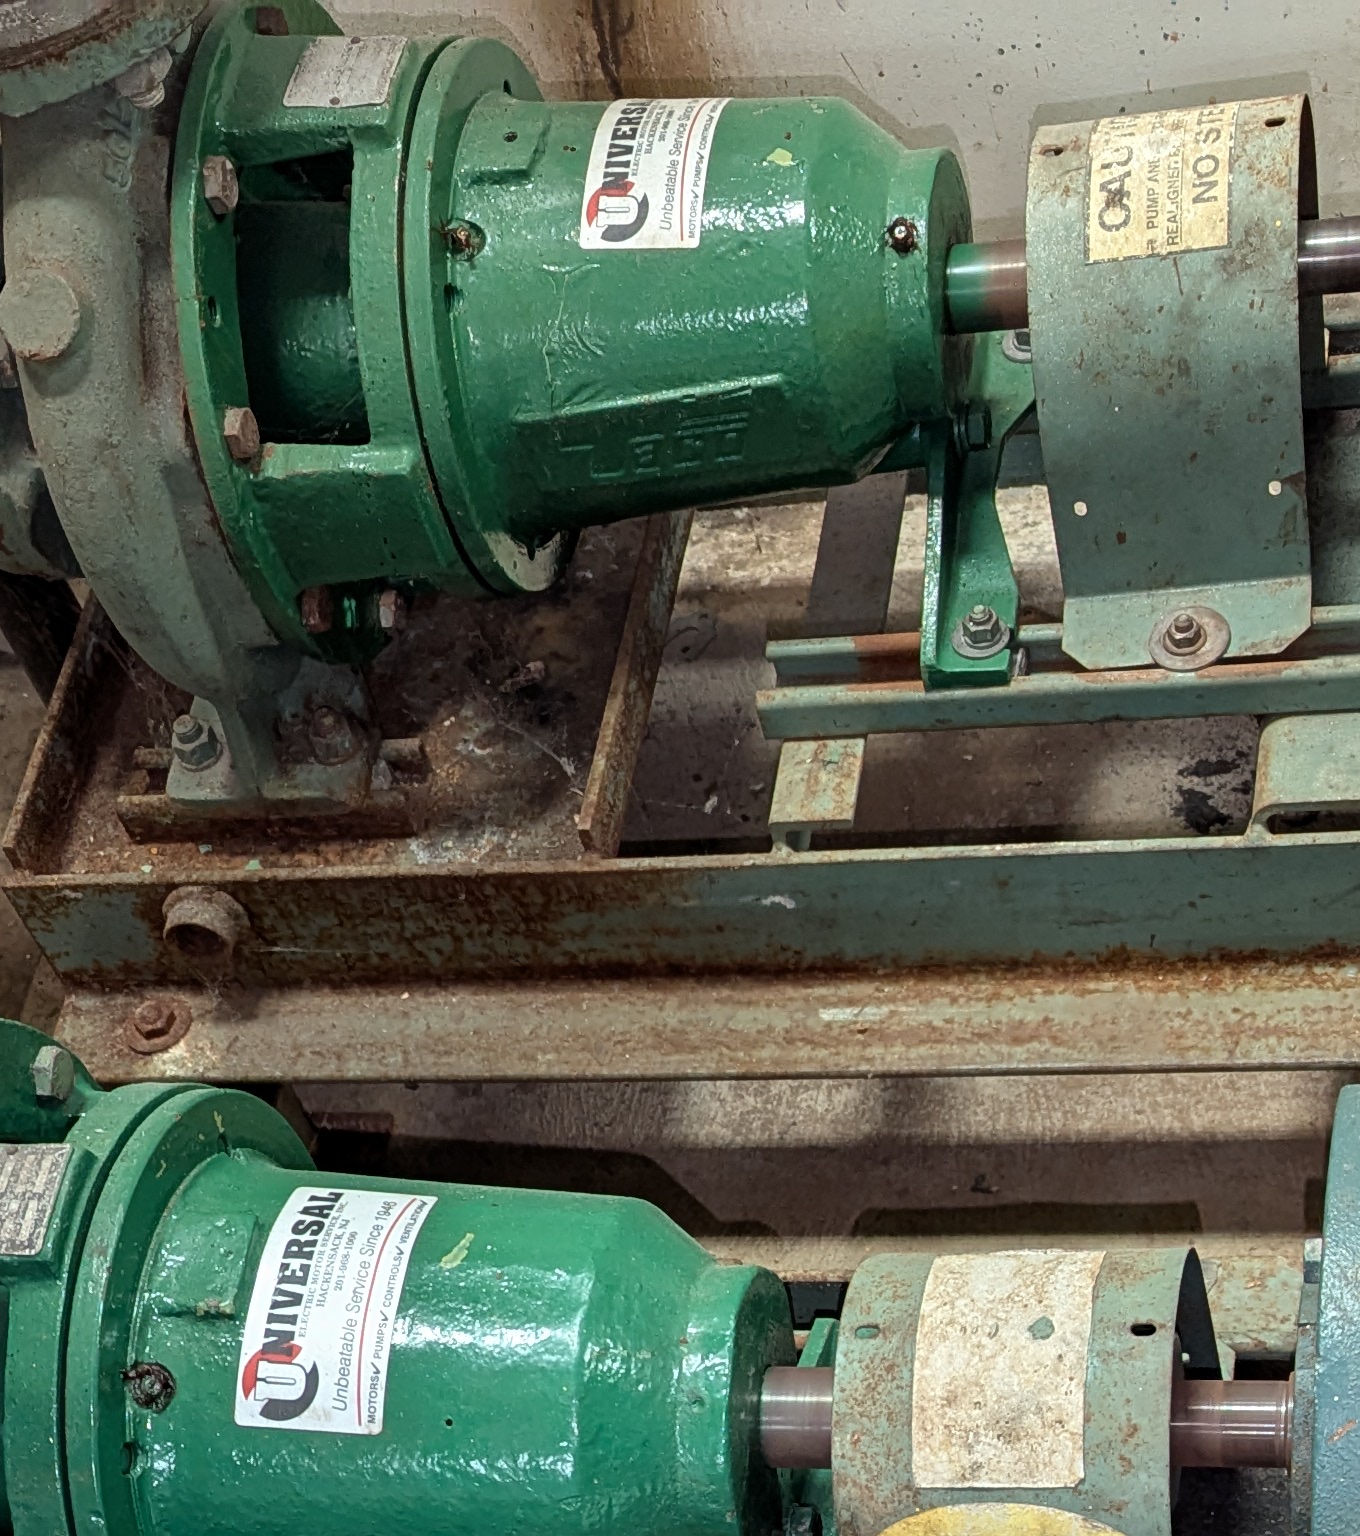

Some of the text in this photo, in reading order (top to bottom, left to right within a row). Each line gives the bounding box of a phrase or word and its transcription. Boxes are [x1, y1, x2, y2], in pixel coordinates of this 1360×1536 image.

[669, 122, 688, 156] Service
[693, 159, 704, 187] PUMPS
[660, 160, 679, 231] Unbeatable
[1147, 188, 1160, 230] PUMP
[1192, 154, 1220, 205] NO
[688, 201, 699, 238] MOTORS
[254, 1192, 344, 1402] UNIVERSAL
[299, 1288, 316, 1338] ELECTRIC
[311, 1252, 325, 1286] MOTOR
[321, 1212, 340, 1250] SERVICE,
[316, 1218, 351, 1308] HACKENSACK, NJ
[332, 1200, 398, 1412] Unbeatable Service Since 1946
[367, 1203, 425, 1424] MOTORS PUMPS CONTROLS VENTILATION
